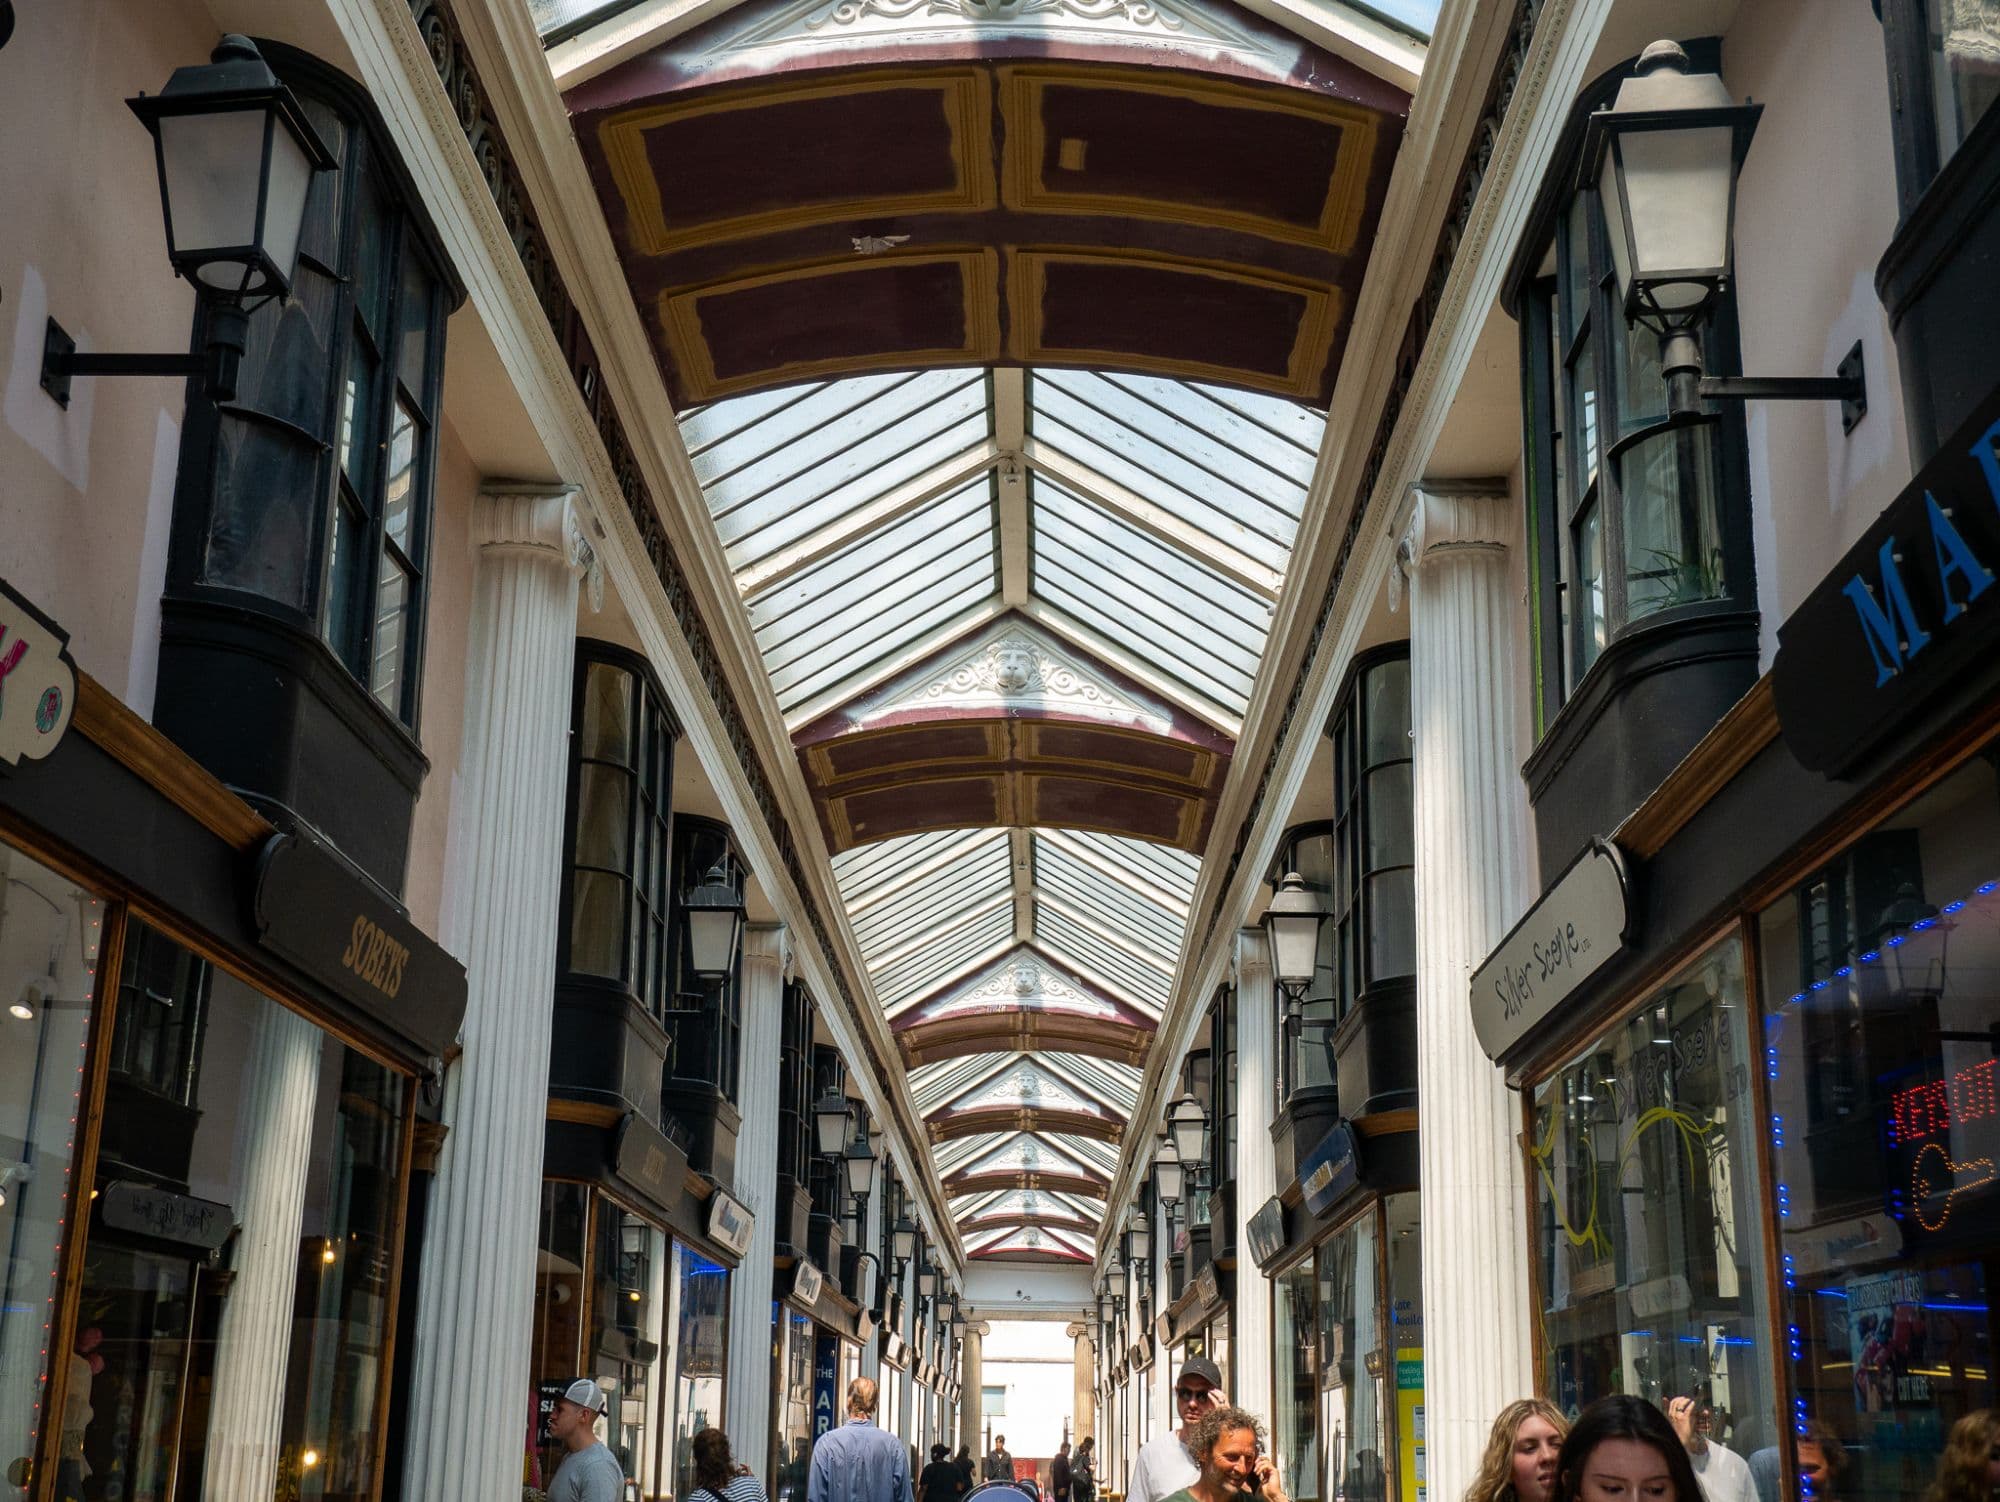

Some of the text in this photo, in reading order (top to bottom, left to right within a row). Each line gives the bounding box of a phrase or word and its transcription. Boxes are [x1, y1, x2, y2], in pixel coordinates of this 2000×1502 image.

[342, 914, 411, 999] SOBEYS
[1495, 963, 1535, 1021] Silver
[1533, 922, 1579, 982] Scene
[1672, 1010, 1731, 1081] Scene
[1893, 1080, 1951, 1142] KEYS
[816, 1368, 833, 1379] THE
